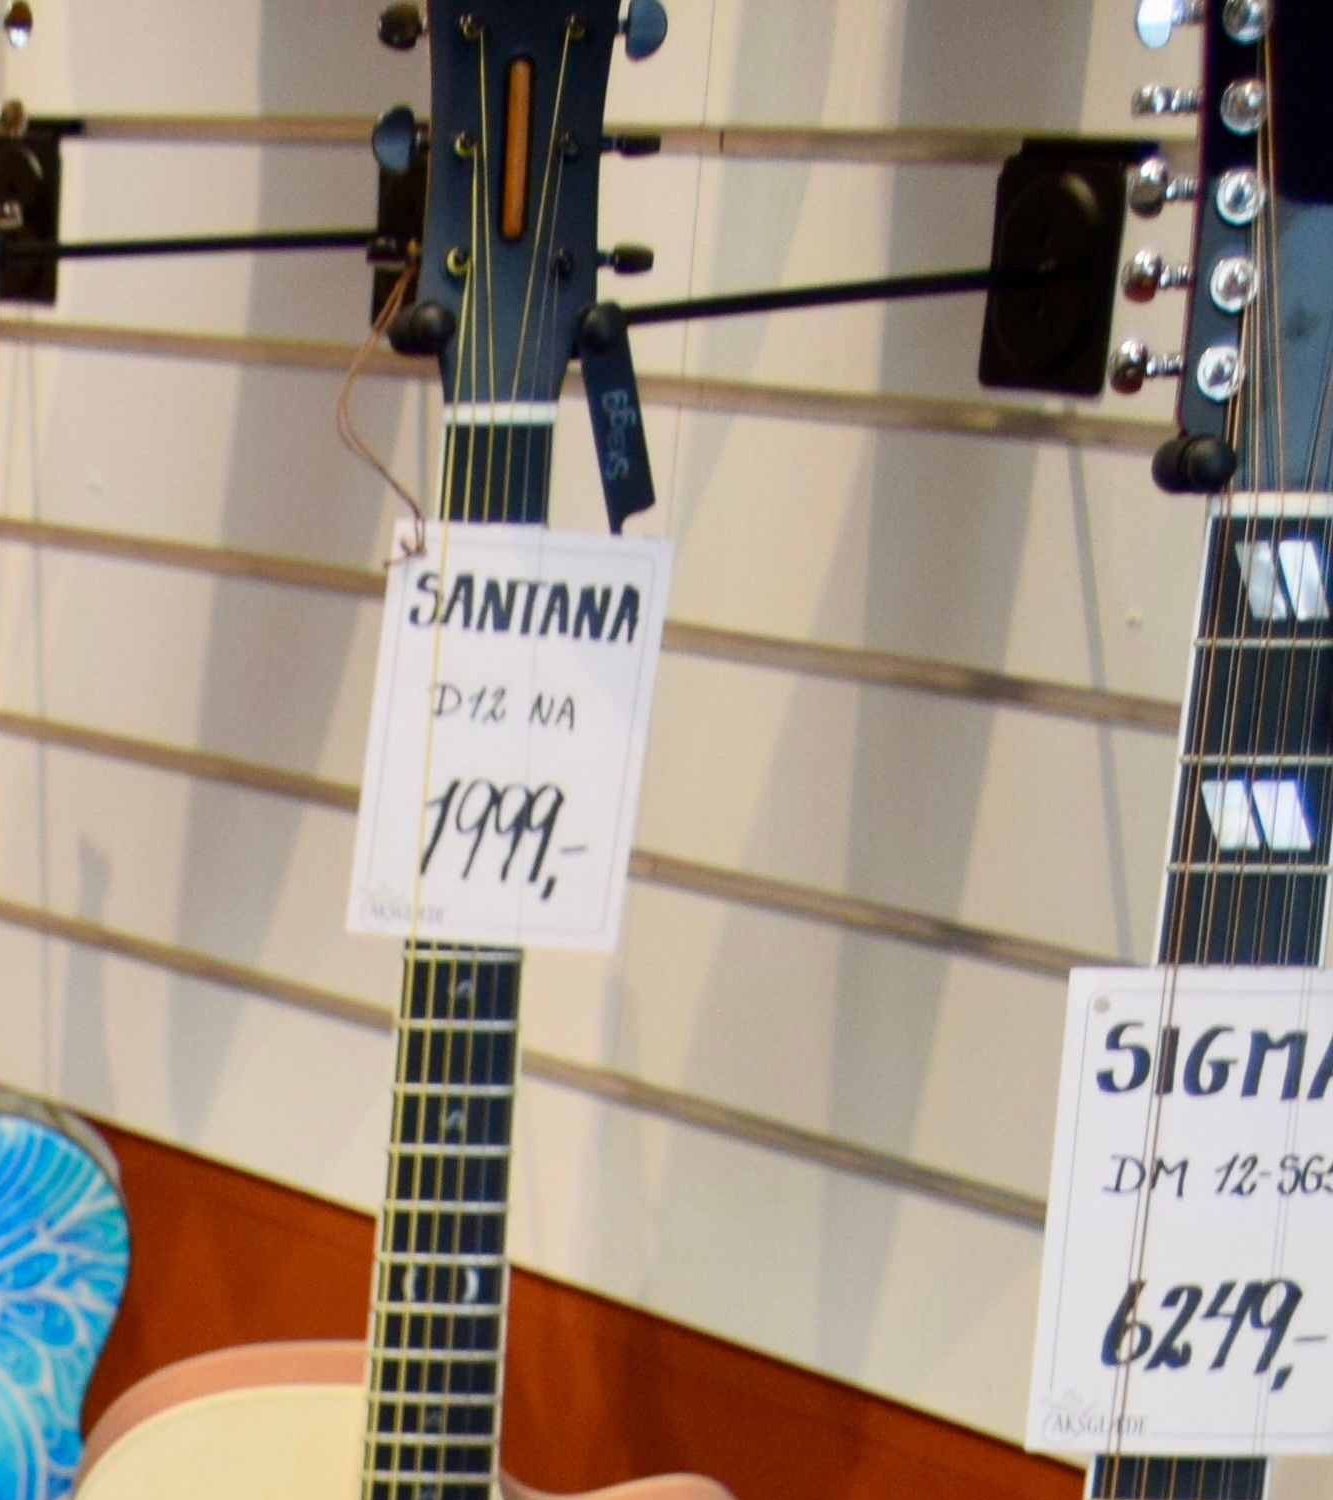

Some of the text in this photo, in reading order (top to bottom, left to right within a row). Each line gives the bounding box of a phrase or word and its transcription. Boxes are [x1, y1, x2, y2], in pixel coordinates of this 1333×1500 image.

[409, 570, 641, 644] SANTANA
[434, 681, 577, 731] D12 NA
[1102, 1153, 1190, 1199] DM
[1100, 1278, 1328, 1392] 6249,-
